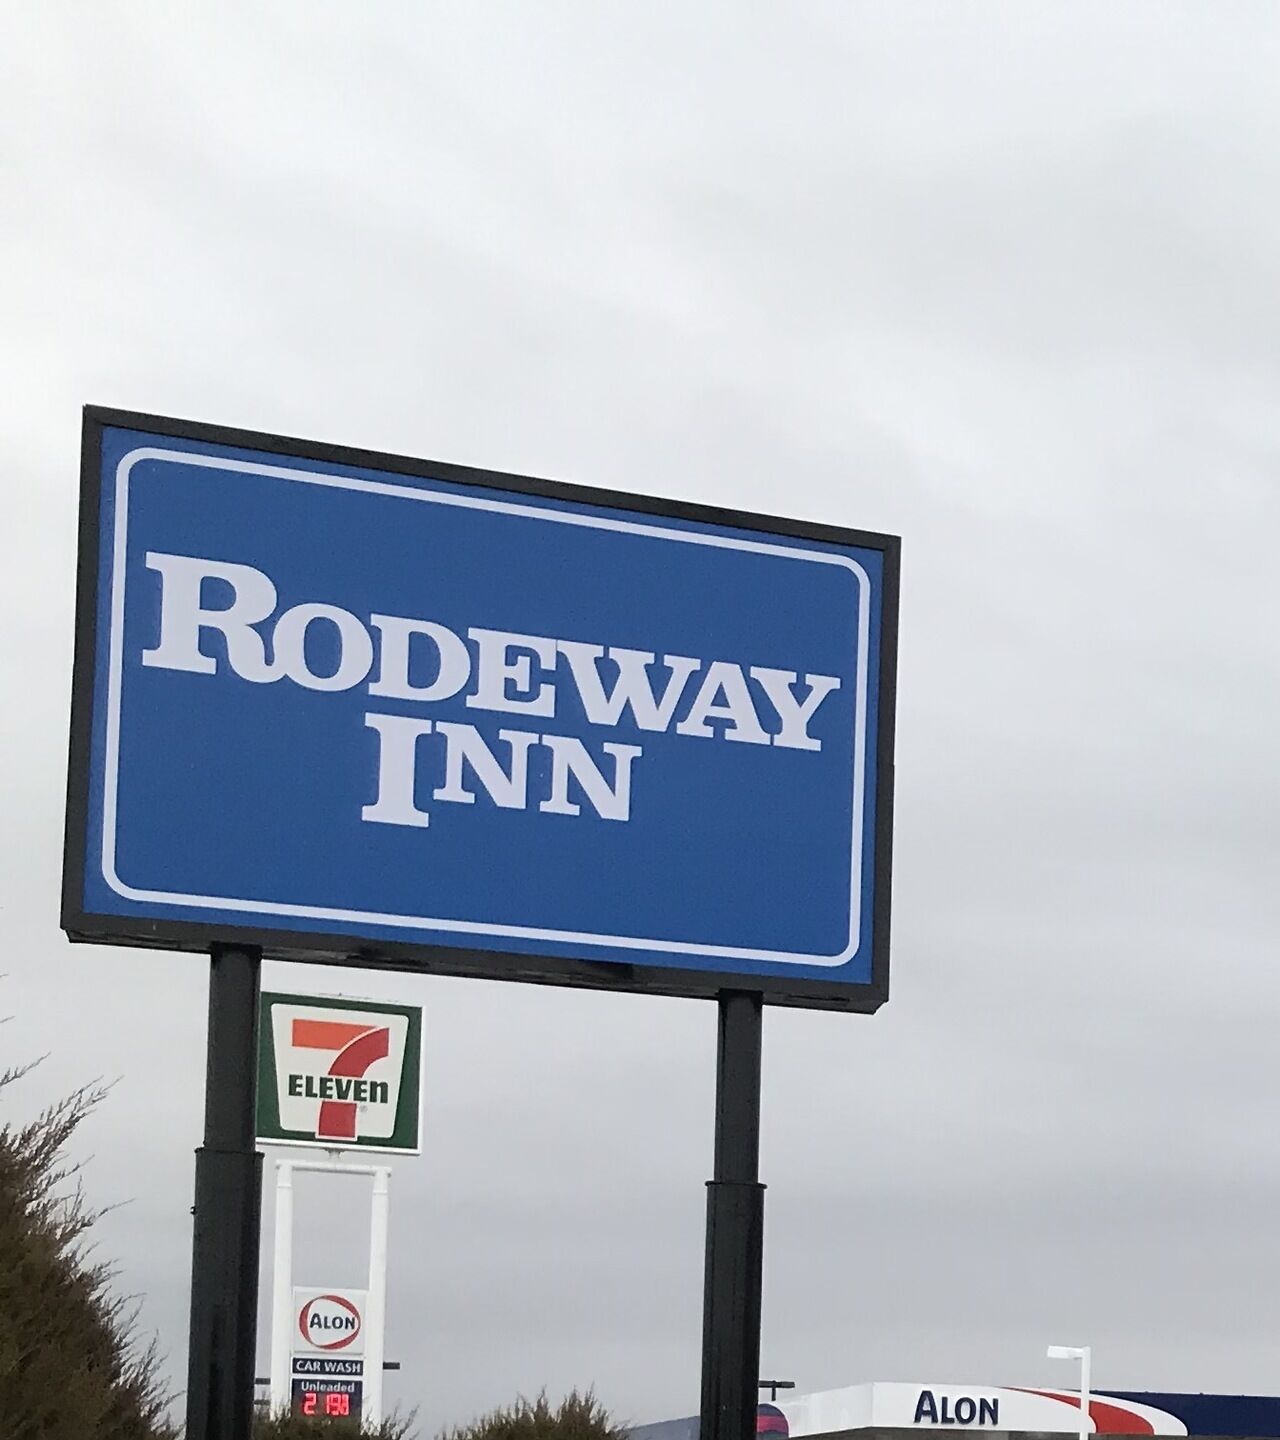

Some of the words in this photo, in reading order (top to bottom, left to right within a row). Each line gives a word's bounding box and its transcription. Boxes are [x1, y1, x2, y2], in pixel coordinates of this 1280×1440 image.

[142, 551, 841, 751] RODEWAY
[361, 712, 643, 828] INN
[291, 1018, 390, 1138] 7
[309, 1312, 356, 1330] ALON
[295, 1360, 321, 1372] CAR
[324, 1361, 361, 1373] WASH
[301, 1381, 355, 1393] Unleaded
[913, 1389, 999, 1426] ALON
